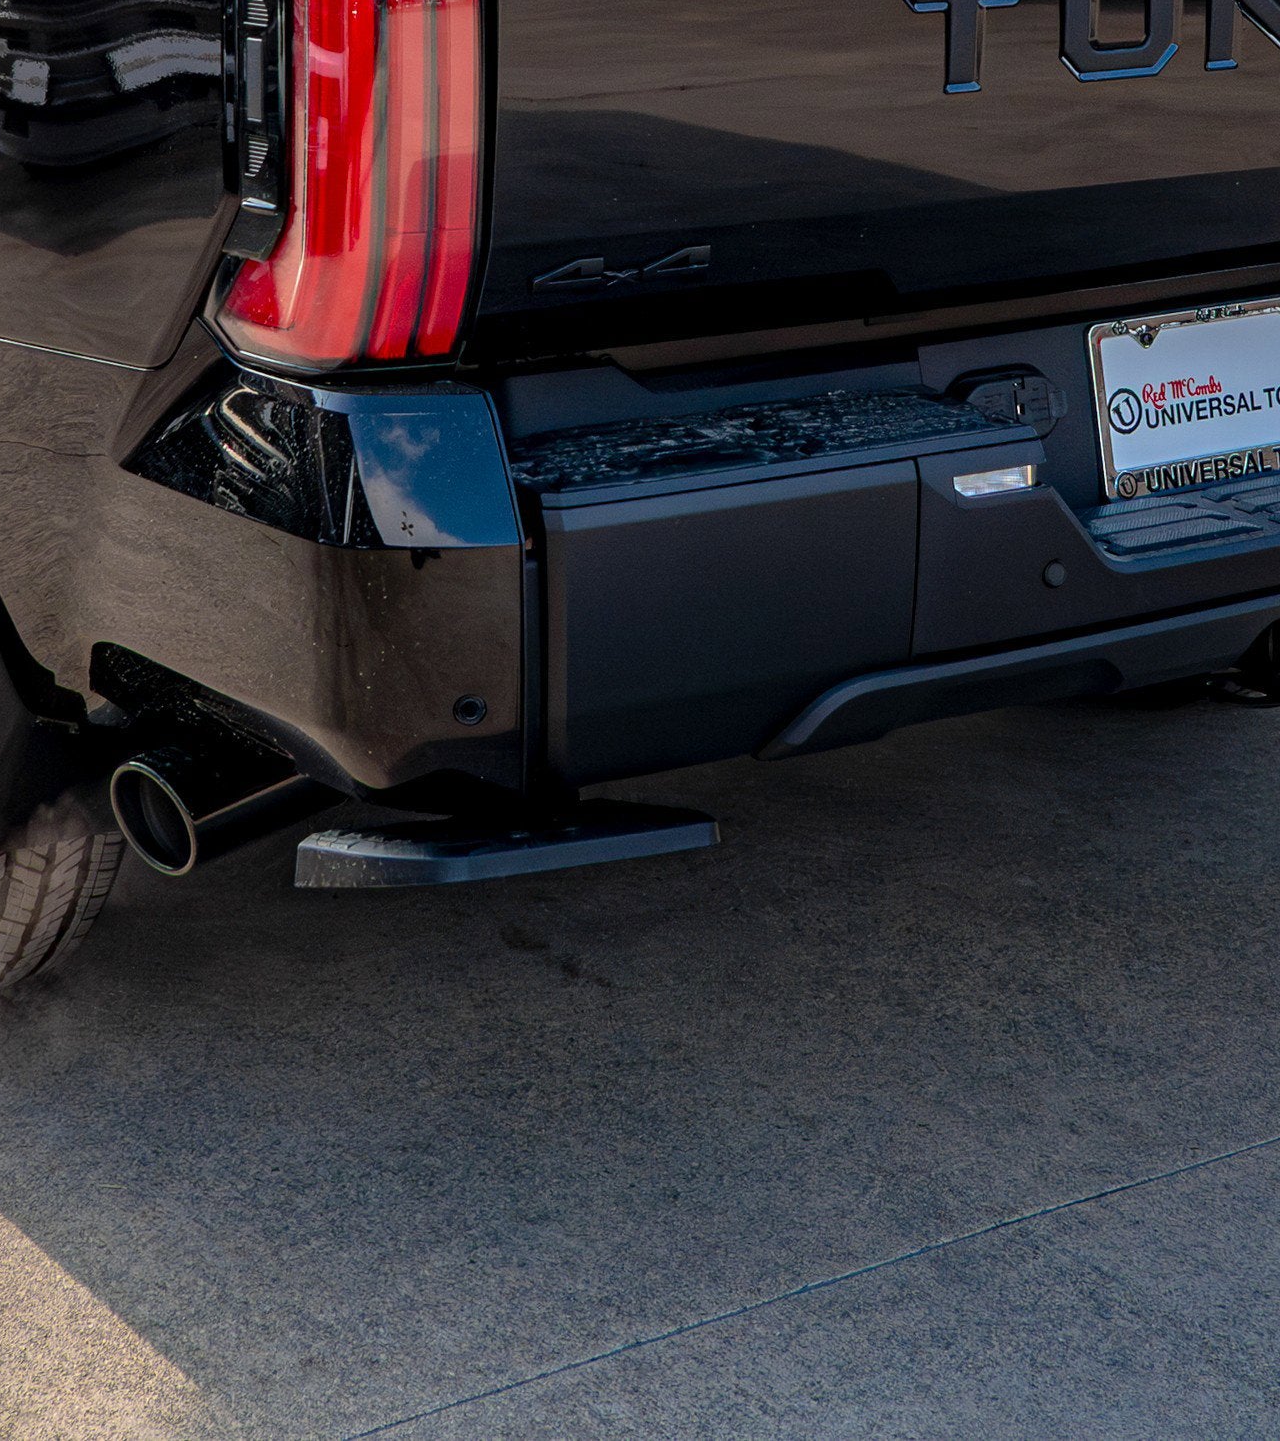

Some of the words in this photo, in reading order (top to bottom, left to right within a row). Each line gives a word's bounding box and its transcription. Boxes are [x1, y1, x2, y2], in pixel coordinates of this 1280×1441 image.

[531, 244, 711, 294] 4x4
[1142, 383, 1166, 409] Red
[1144, 389, 1262, 429] UNIVERSAL
[1144, 449, 1272, 492] UNIVERSAL
